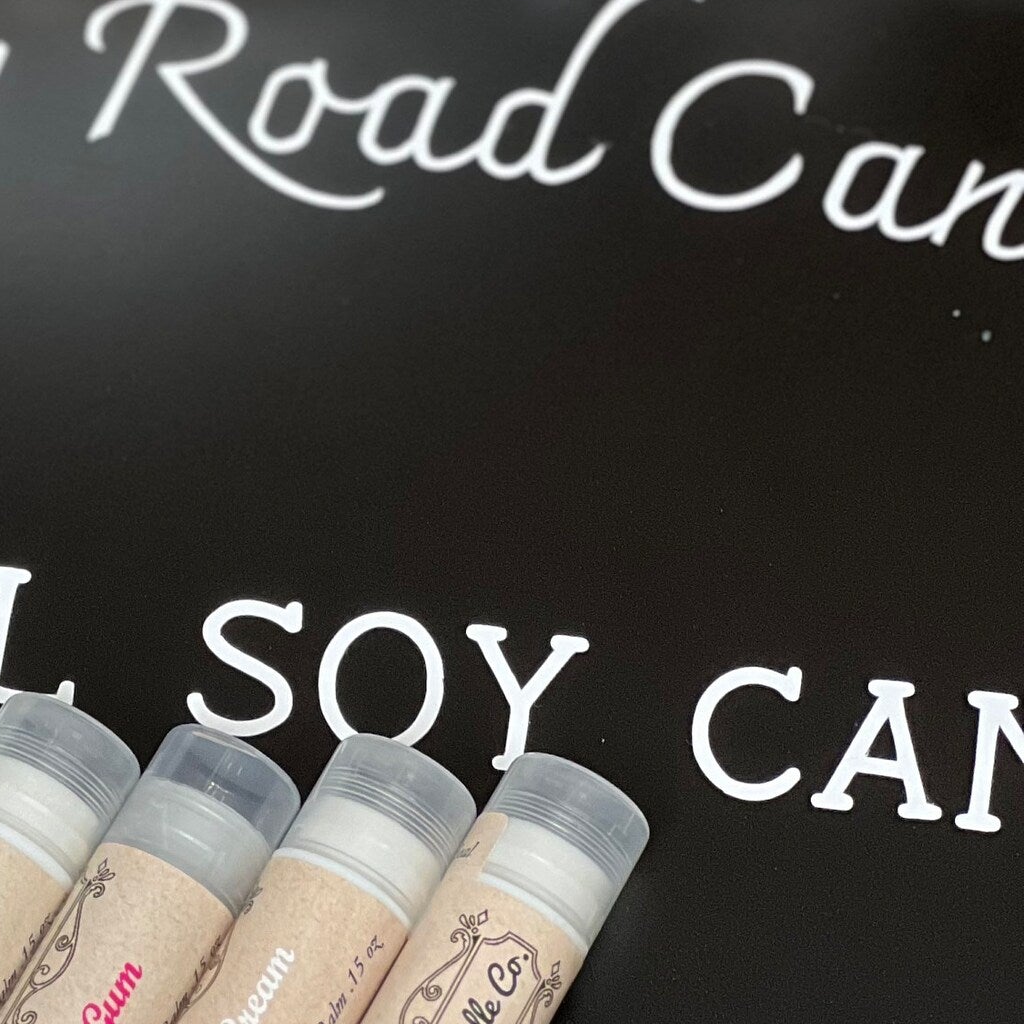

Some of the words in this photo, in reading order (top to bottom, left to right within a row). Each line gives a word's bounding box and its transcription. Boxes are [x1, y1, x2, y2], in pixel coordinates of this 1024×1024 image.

[652, 61, 1024, 262] Can
[185, 598, 600, 772] SOY
[690, 666, 1024, 834] CAN
[318, 992, 348, 1024] alm
[487, 953, 530, 998] Co.
